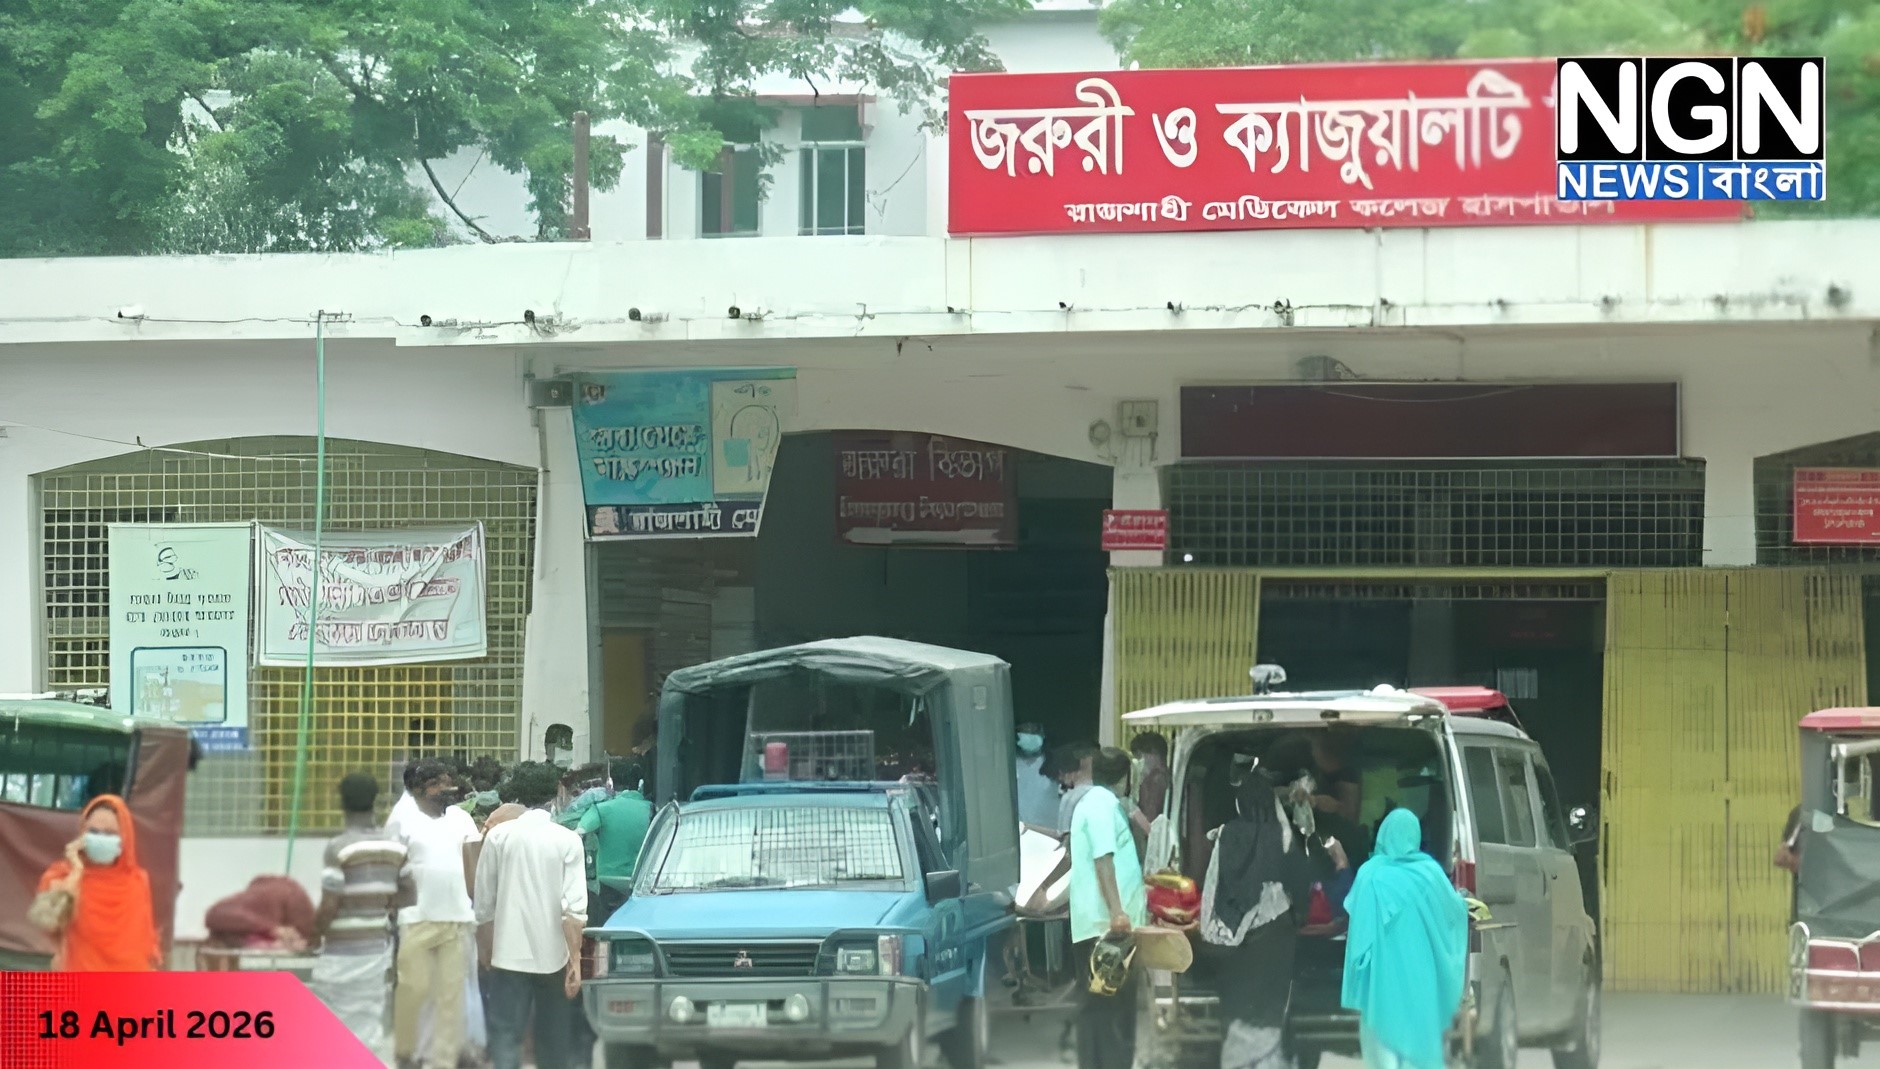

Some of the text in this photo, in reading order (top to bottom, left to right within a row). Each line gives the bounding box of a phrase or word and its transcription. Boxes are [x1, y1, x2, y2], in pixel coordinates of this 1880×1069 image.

[963, 67, 1532, 190] জরুরী ও ক্যাজুয়ালটি
